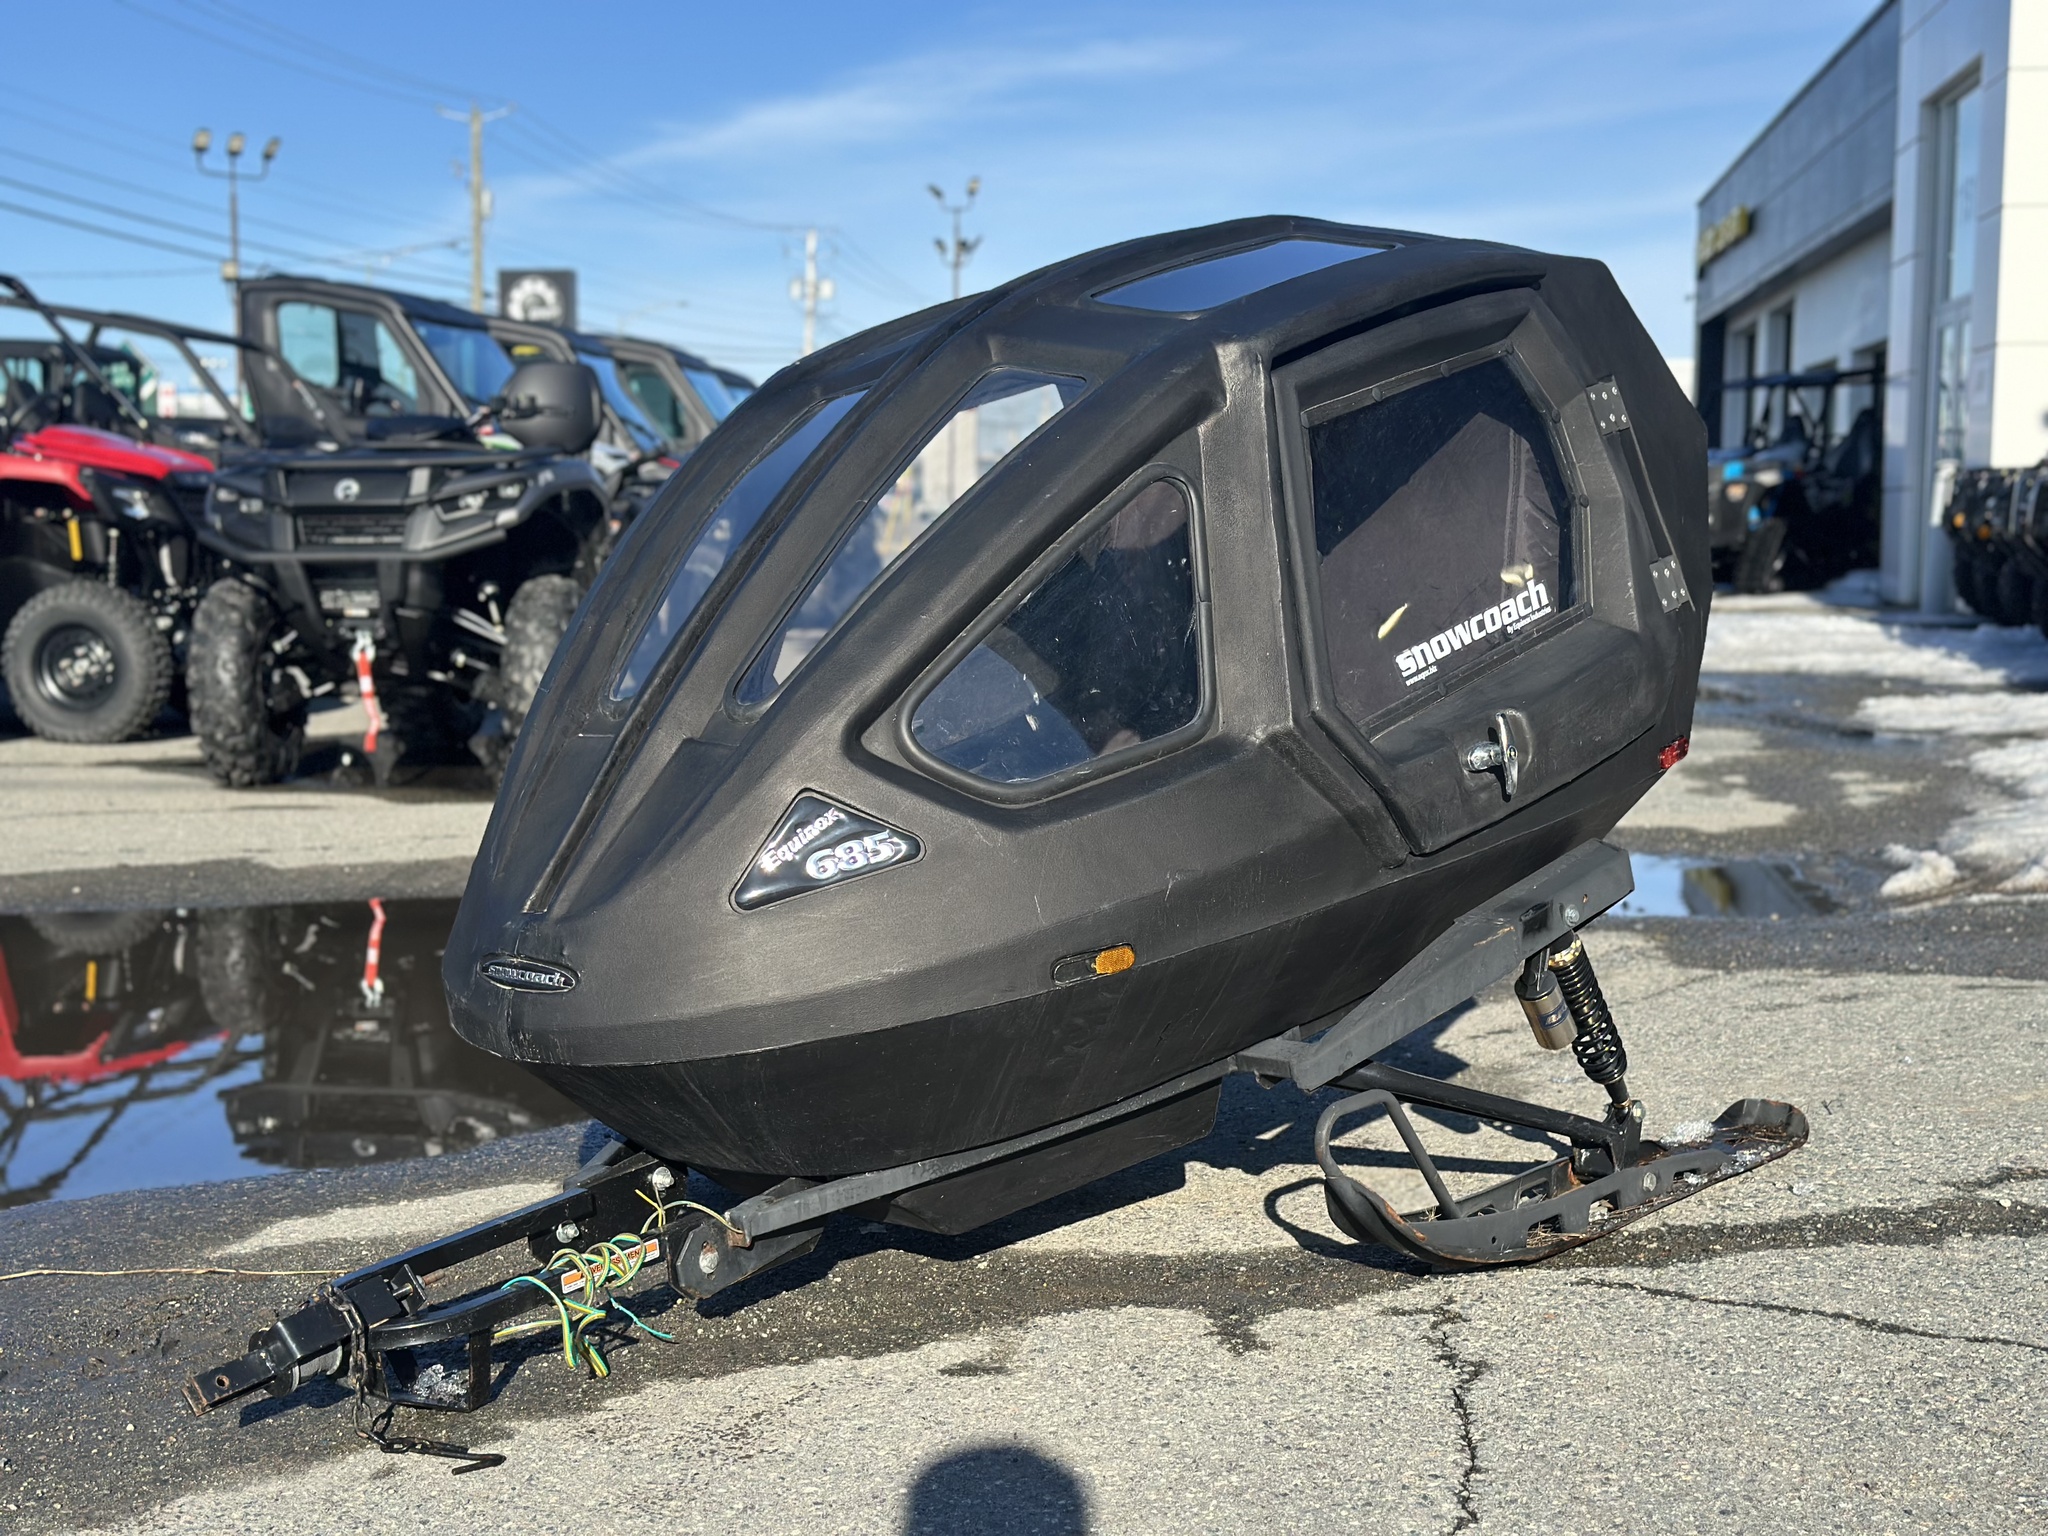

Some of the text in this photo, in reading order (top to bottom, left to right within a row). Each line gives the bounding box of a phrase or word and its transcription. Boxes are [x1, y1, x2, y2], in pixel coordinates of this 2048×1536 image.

[1395, 579, 1549, 677] snowcoach
[761, 808, 846, 873] Equinox
[805, 829, 897, 880] 685
